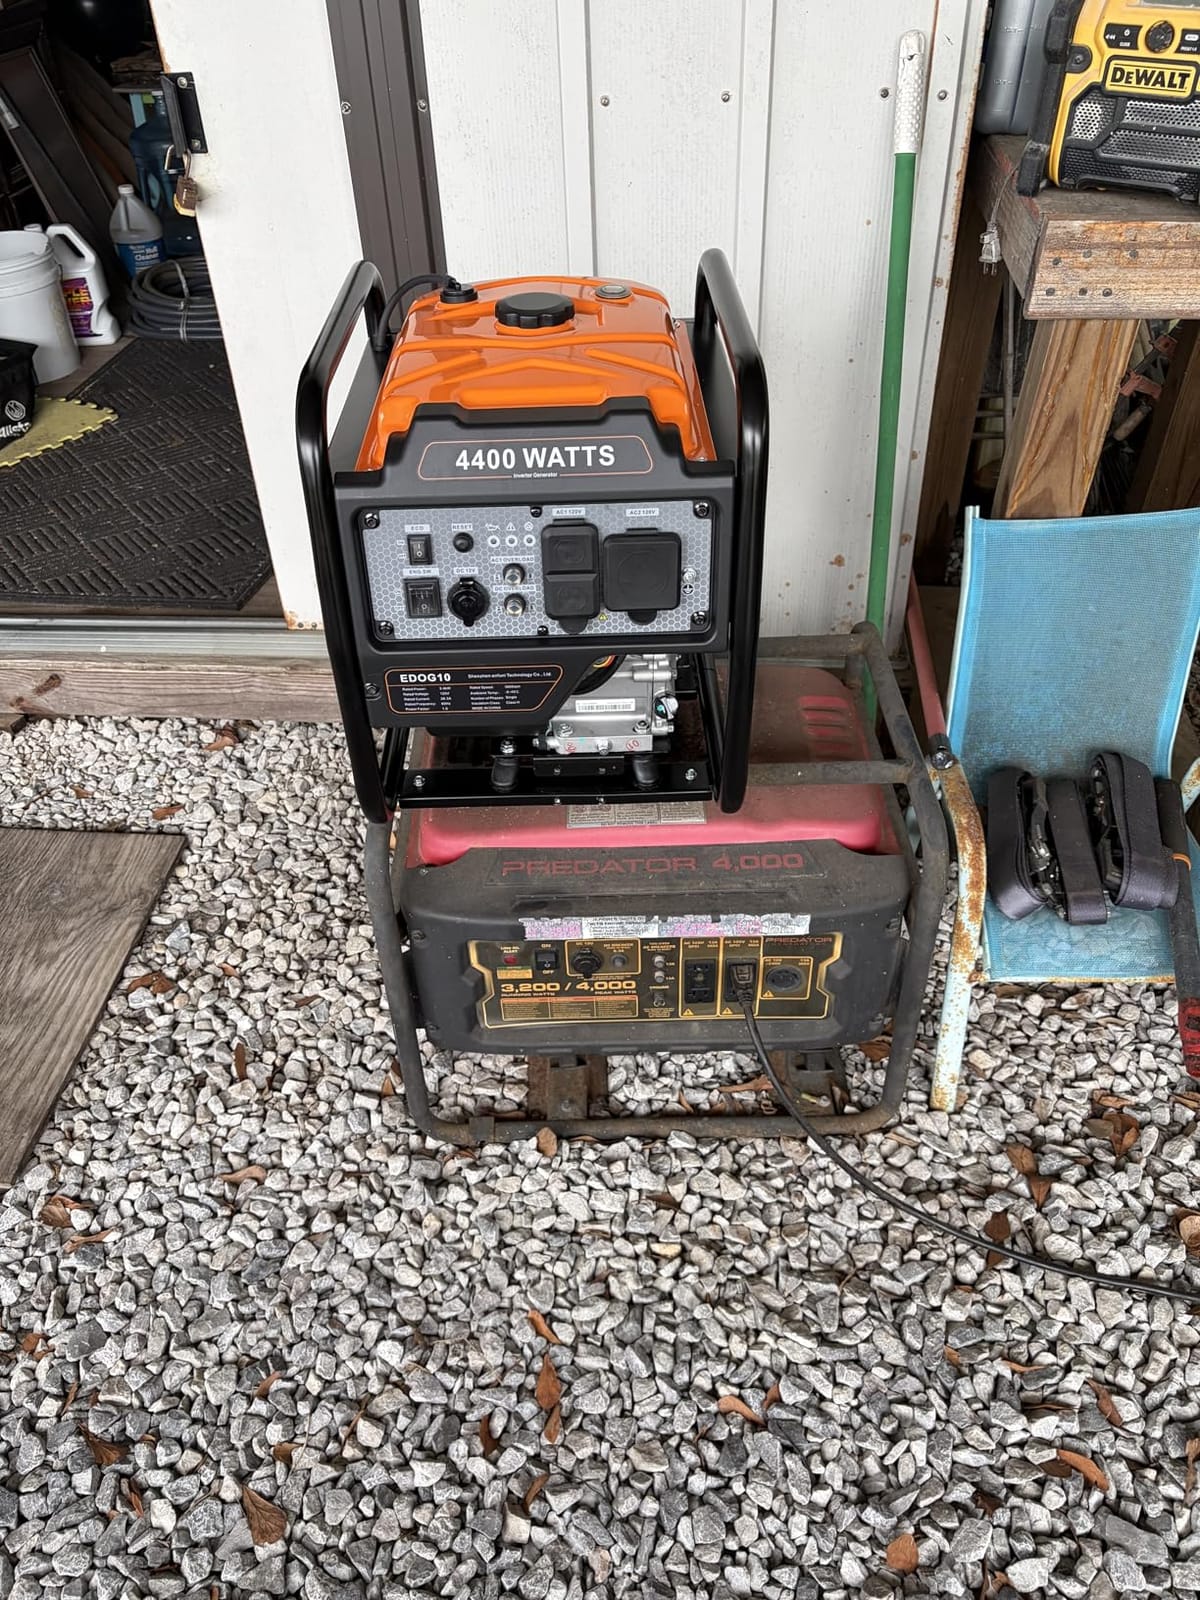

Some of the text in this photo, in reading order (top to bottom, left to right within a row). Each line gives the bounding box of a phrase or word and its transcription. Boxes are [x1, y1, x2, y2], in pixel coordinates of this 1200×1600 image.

[455, 445, 616, 471] 4400 WATTS
[400, 673, 451, 684] EDOG10
[501, 853, 805, 876] PREDATOR 4,000
[500, 980, 637, 993] 3,200 / 4,000
